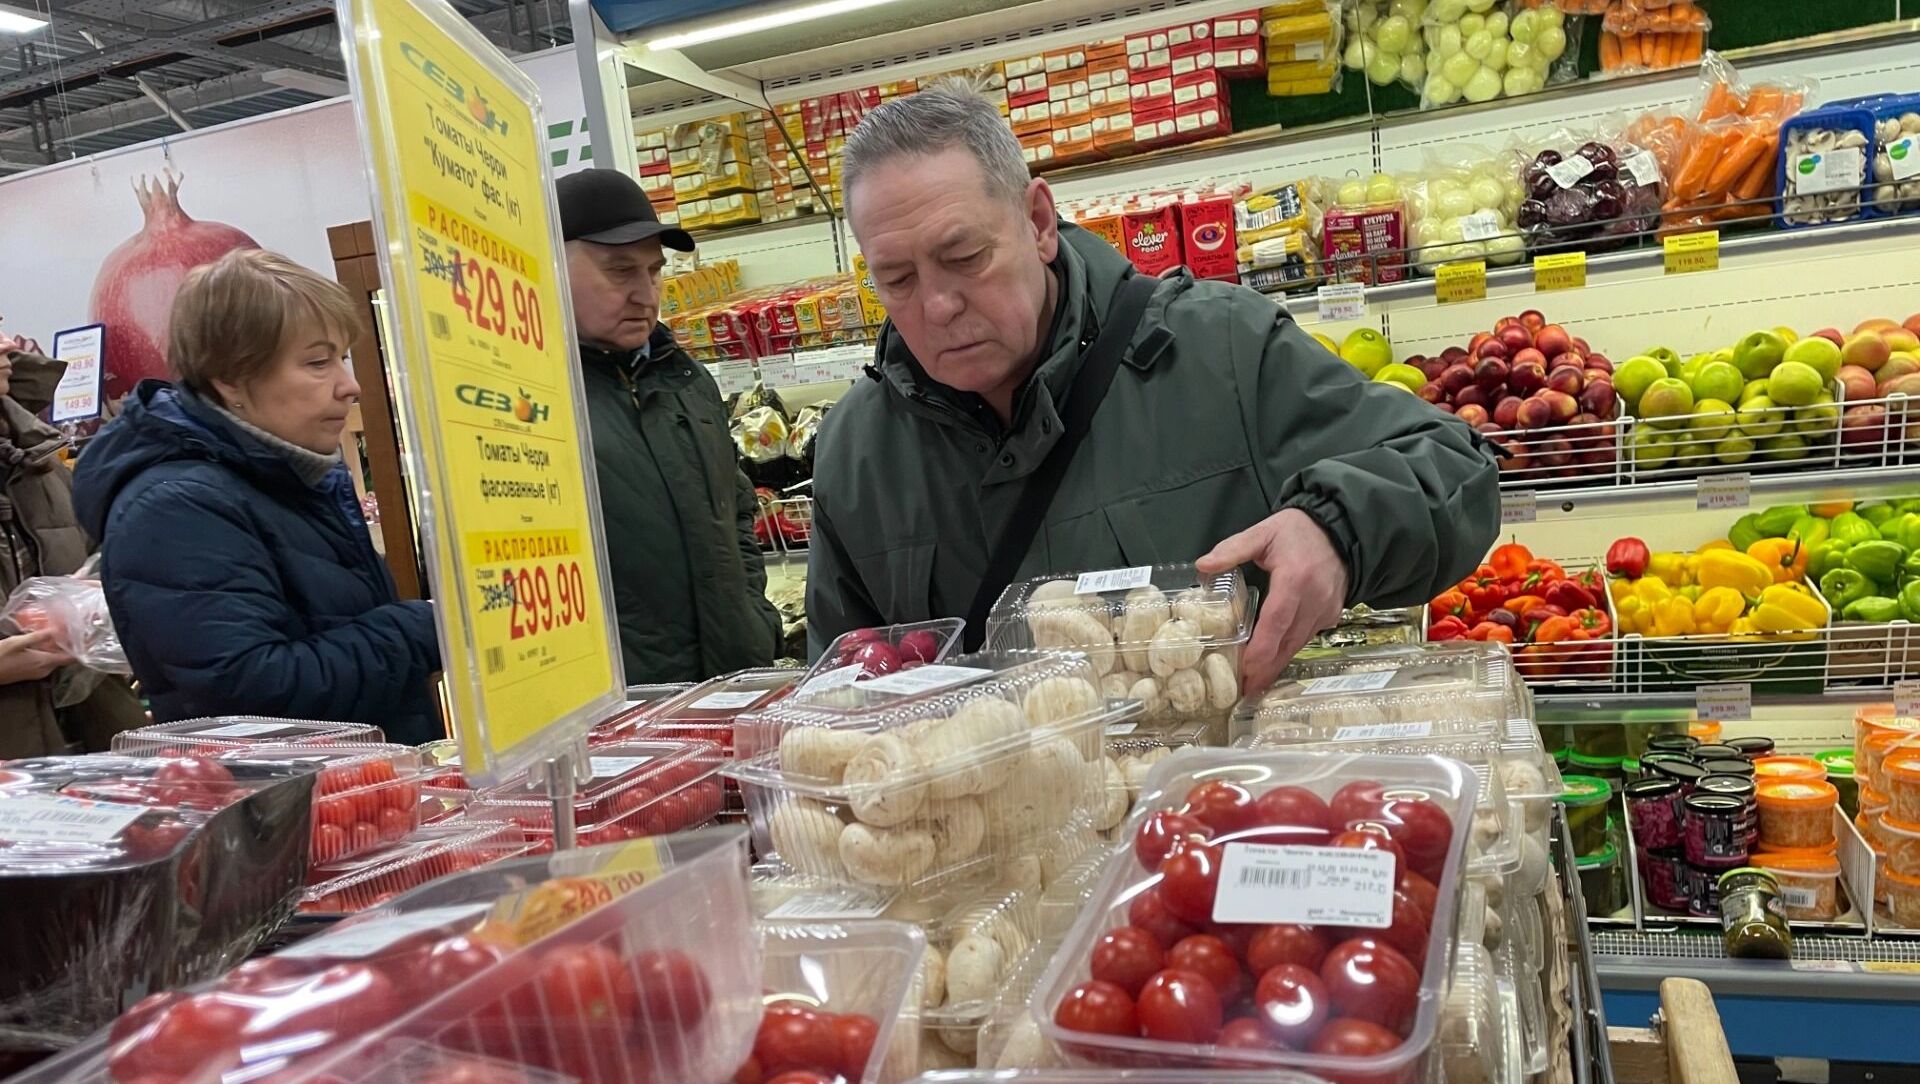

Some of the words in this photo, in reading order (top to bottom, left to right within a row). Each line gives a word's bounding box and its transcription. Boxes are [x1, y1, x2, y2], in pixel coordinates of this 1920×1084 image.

[424, 136, 478, 190] "Кумато"
[481, 176, 505, 209] фас.
[425, 103, 475, 152] Томаты
[475, 134, 507, 181] Черри
[428, 205, 528, 276] РАСПРОДАЖА
[1131, 231, 1169, 248] clever
[452, 249, 544, 351] 429.90
[476, 435, 521, 464] Томаты
[521, 442, 551, 472] Черри
[480, 473, 546, 503] фасованные
[484, 535, 570, 563] РАСПРОДАЖА
[503, 561, 585, 641] 299.90
